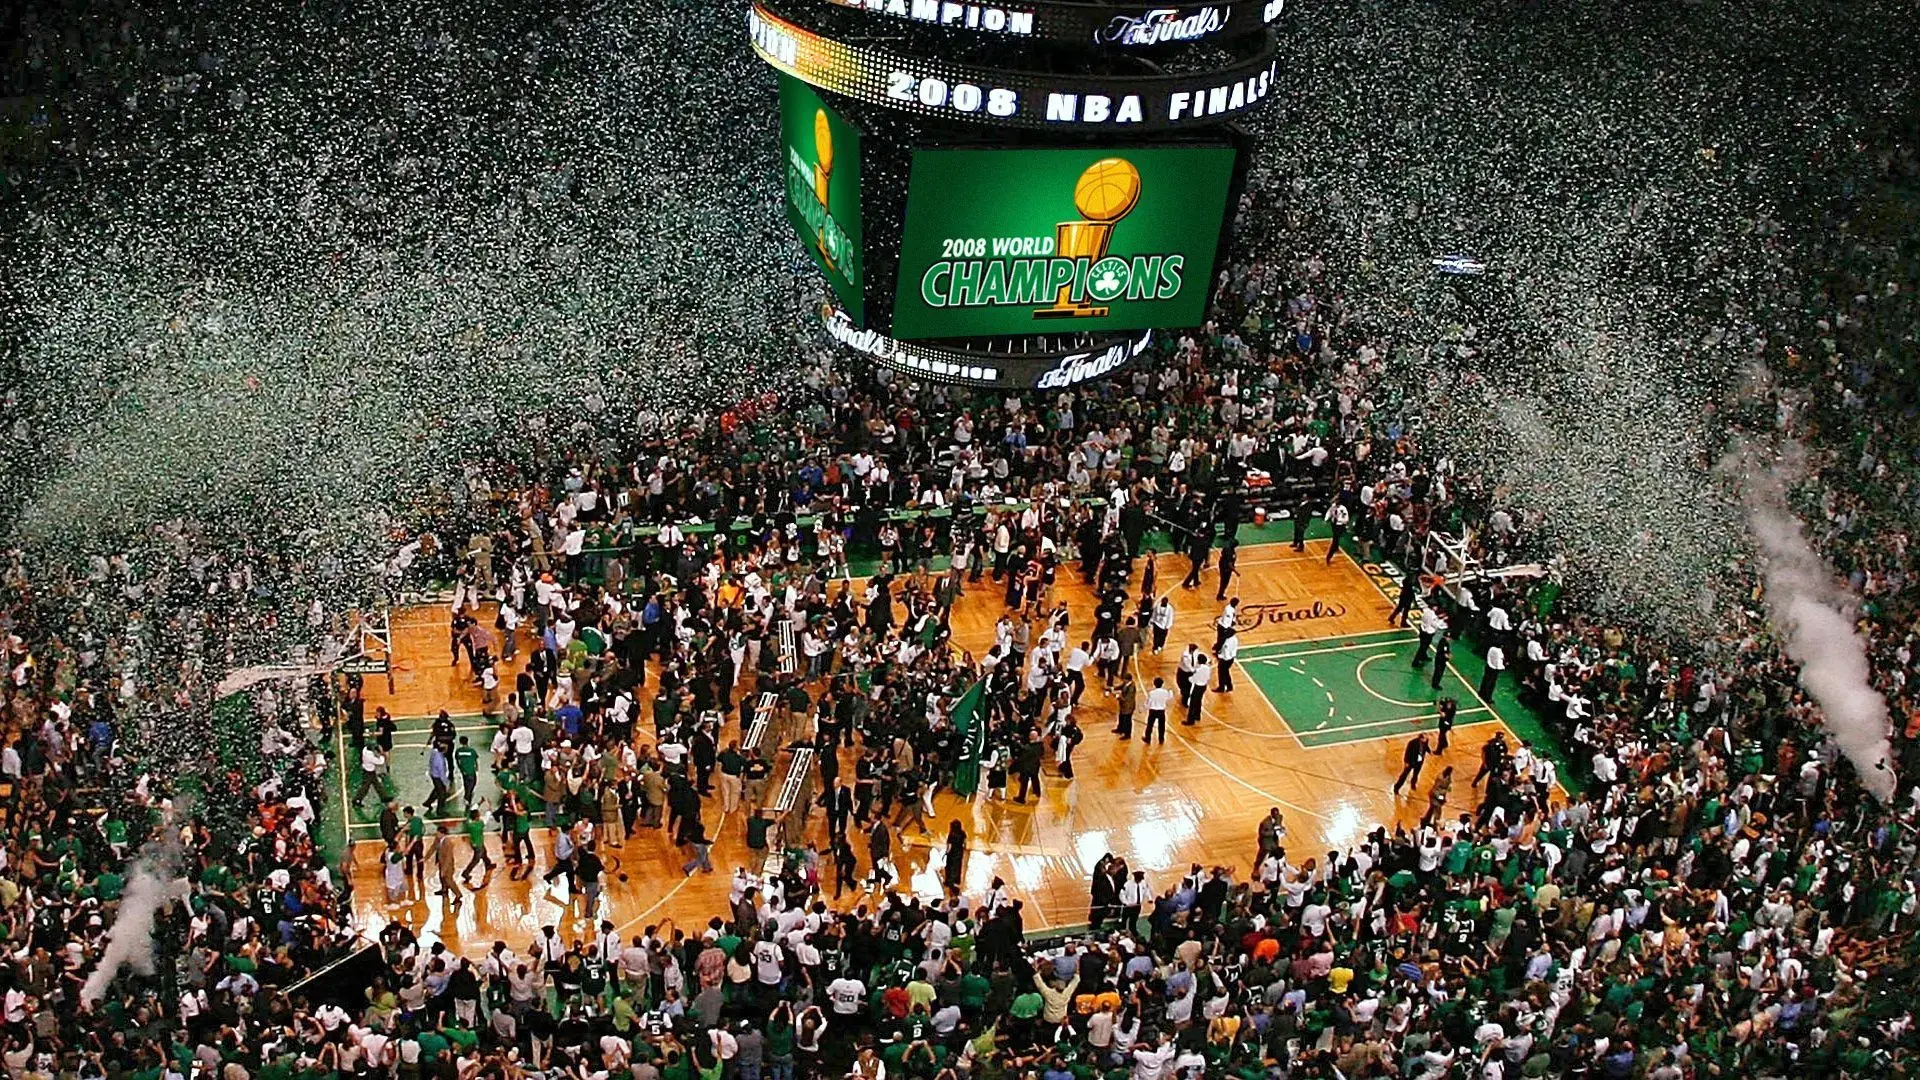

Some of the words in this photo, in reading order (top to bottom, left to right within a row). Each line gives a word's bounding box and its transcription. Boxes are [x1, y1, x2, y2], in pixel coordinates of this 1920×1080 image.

[1146, 9, 1220, 45] Finals
[886, 72, 1017, 118] 2008
[1046, 93, 1143, 122] NBA
[1169, 71, 1270, 120] FINALS
[941, 238, 987, 258] 2008
[992, 237, 1055, 256] WORLD
[921, 255, 1185, 307] CHAMPIONS
[1091, 261, 1127, 278] CELTICS
[833, 310, 886, 357] Finals
[1060, 353, 1124, 387] Finals
[1238, 601, 1346, 632] Finals
